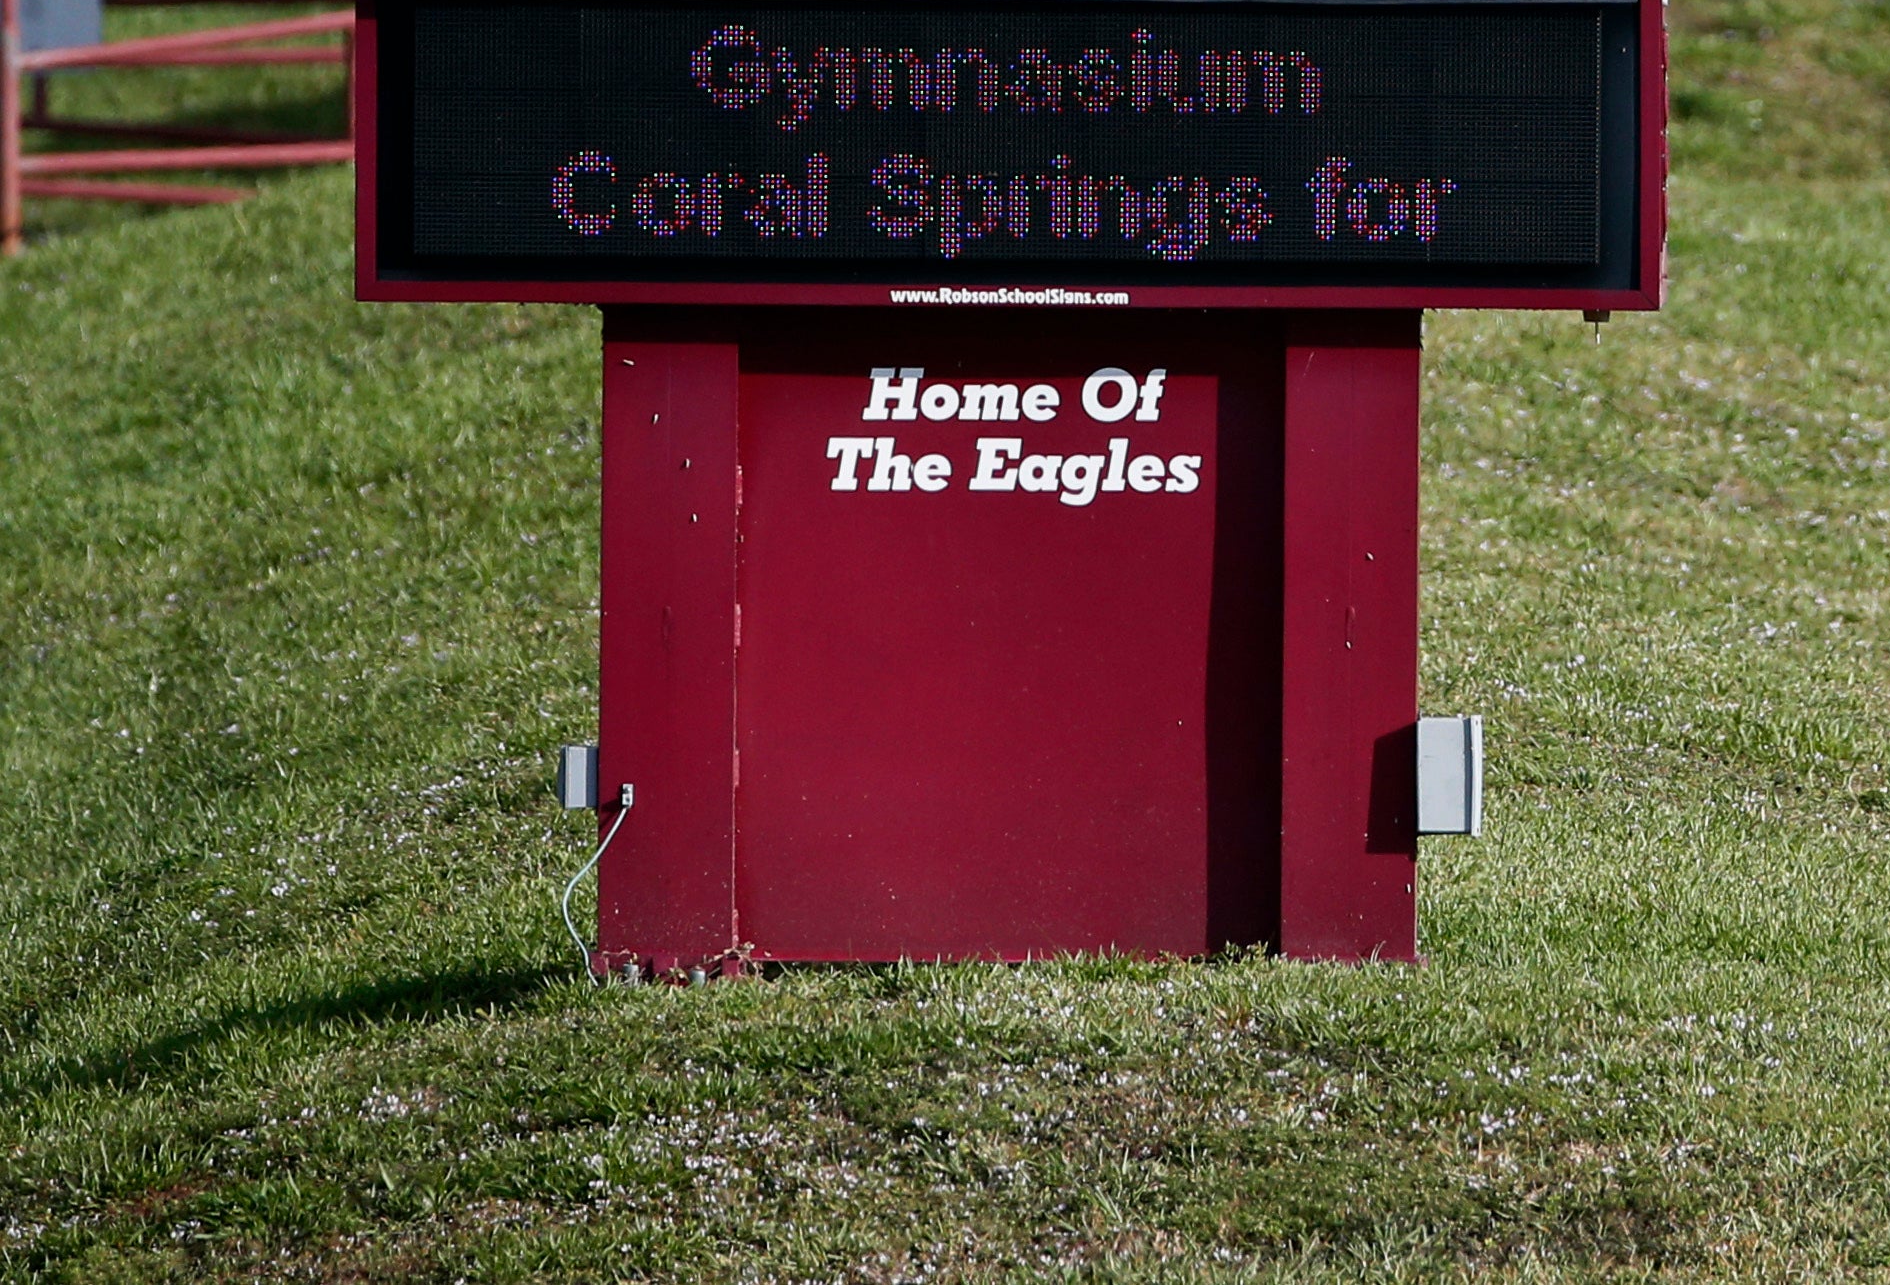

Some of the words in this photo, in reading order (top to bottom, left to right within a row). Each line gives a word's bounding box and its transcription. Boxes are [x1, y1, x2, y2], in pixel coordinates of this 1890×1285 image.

[691, 24, 1324, 132] Gymnasium
[550, 150, 832, 239] Coral
[866, 152, 1275, 262] Springs
[1306, 156, 1458, 243] for
[889, 287, 1130, 306] www.RobsonSchoolSigns.com
[861, 367, 1061, 422] Home
[1081, 367, 1168, 423] Of
[825, 436, 953, 492] The
[968, 436, 1202, 507] Eagles
